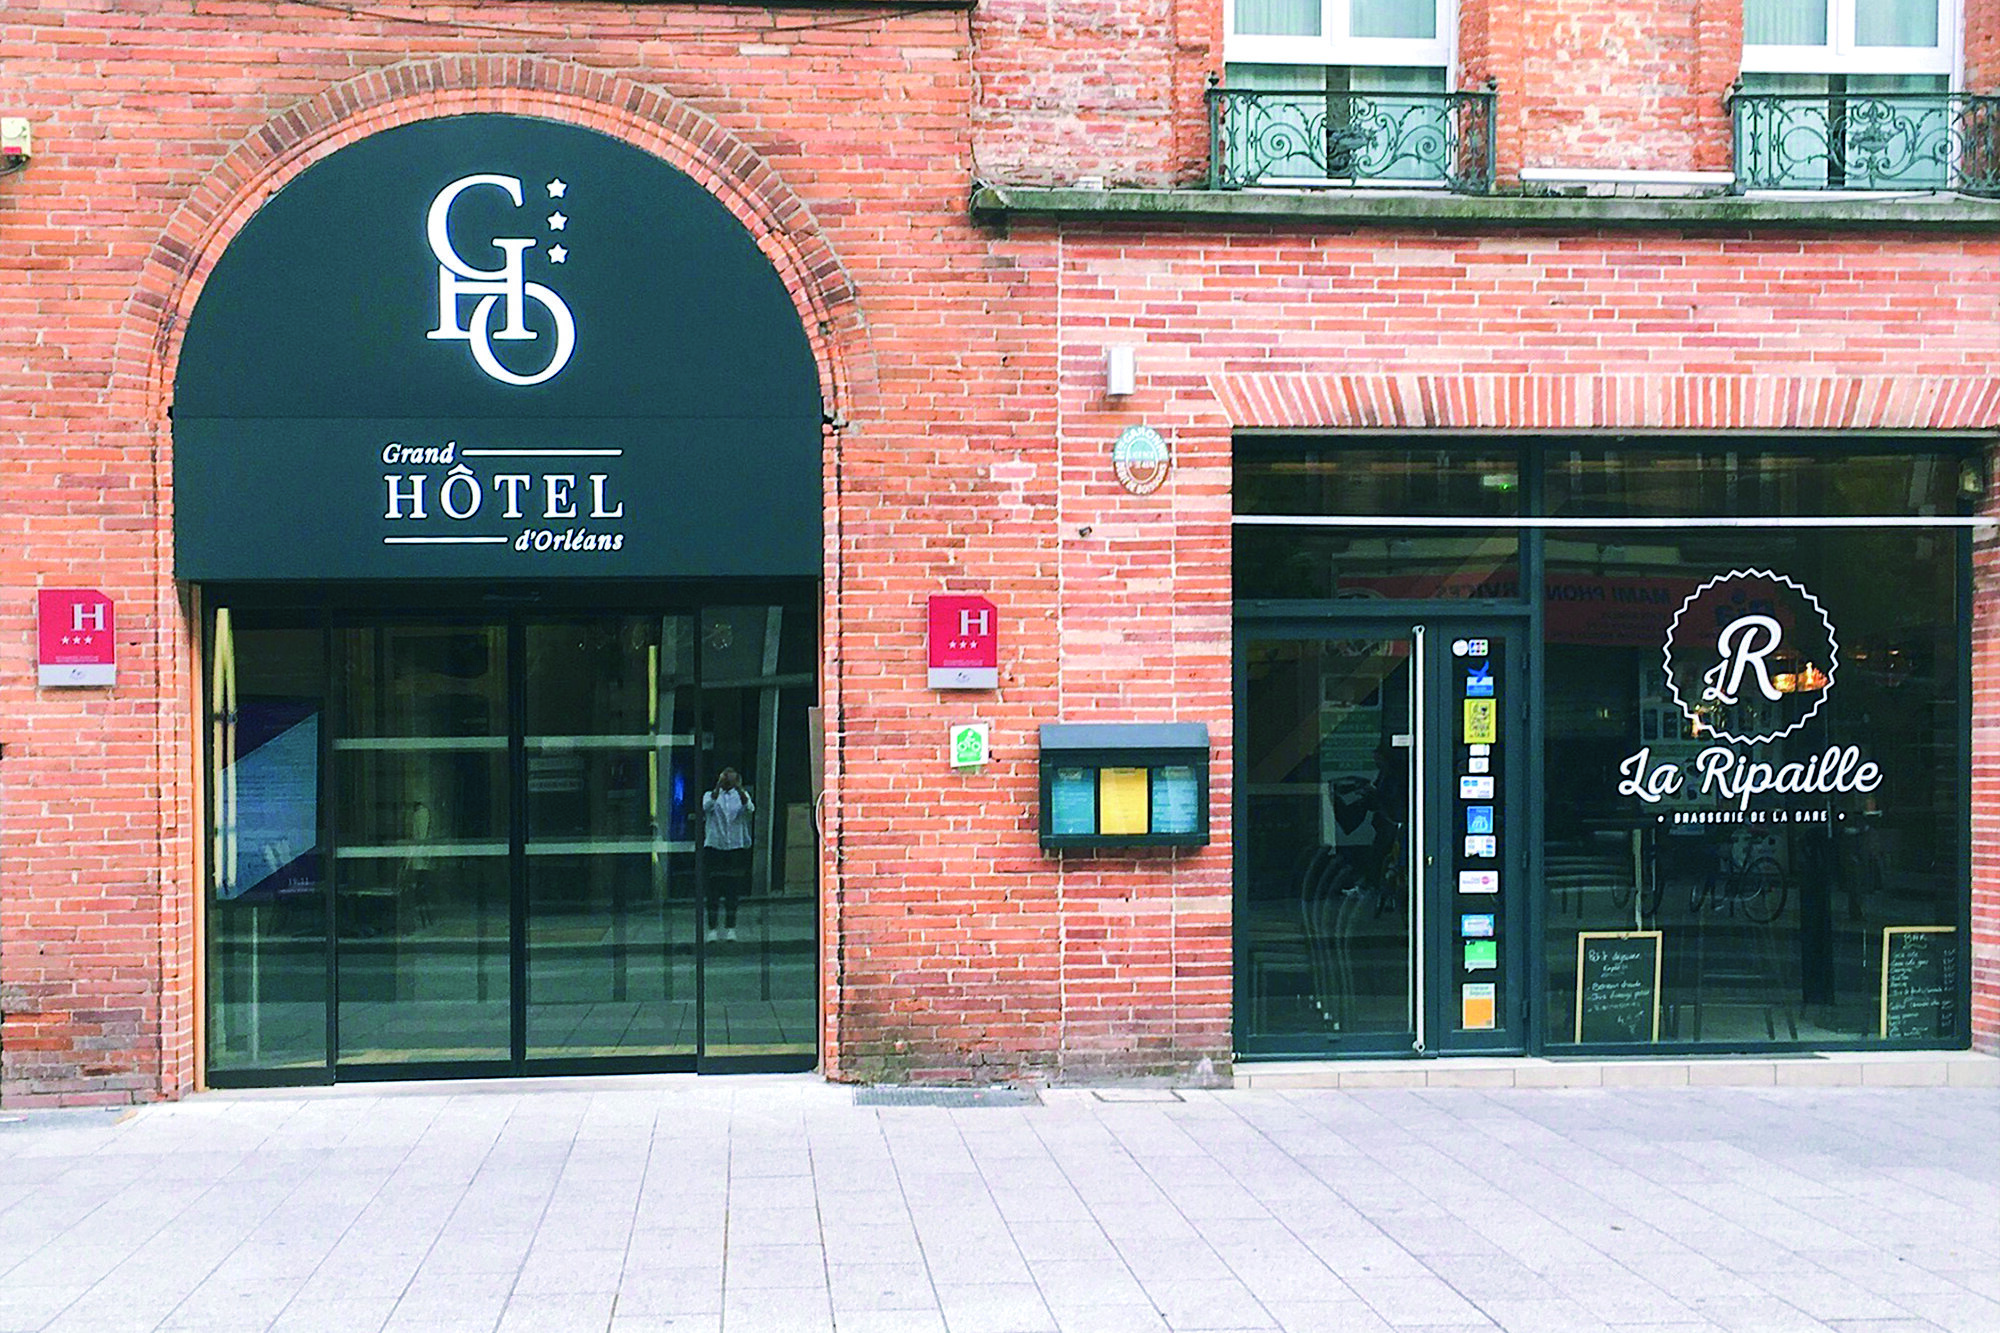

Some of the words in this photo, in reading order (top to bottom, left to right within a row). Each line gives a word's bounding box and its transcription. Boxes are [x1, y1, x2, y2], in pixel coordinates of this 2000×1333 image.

[382, 441, 456, 464] Grand
[384, 463, 624, 519] HÔTEL
[514, 527, 625, 551] d'Orléans
[71, 603, 106, 632] H
[959, 609, 991, 637] H
[1618, 747, 1684, 803] La
[1696, 745, 1883, 811] Ripaille
[1674, 811, 1744, 824] BRASSERIE
[1750, 811, 1766, 823] DE
[1772, 811, 1788, 823] LA
[1795, 810, 1828, 823] GARE
